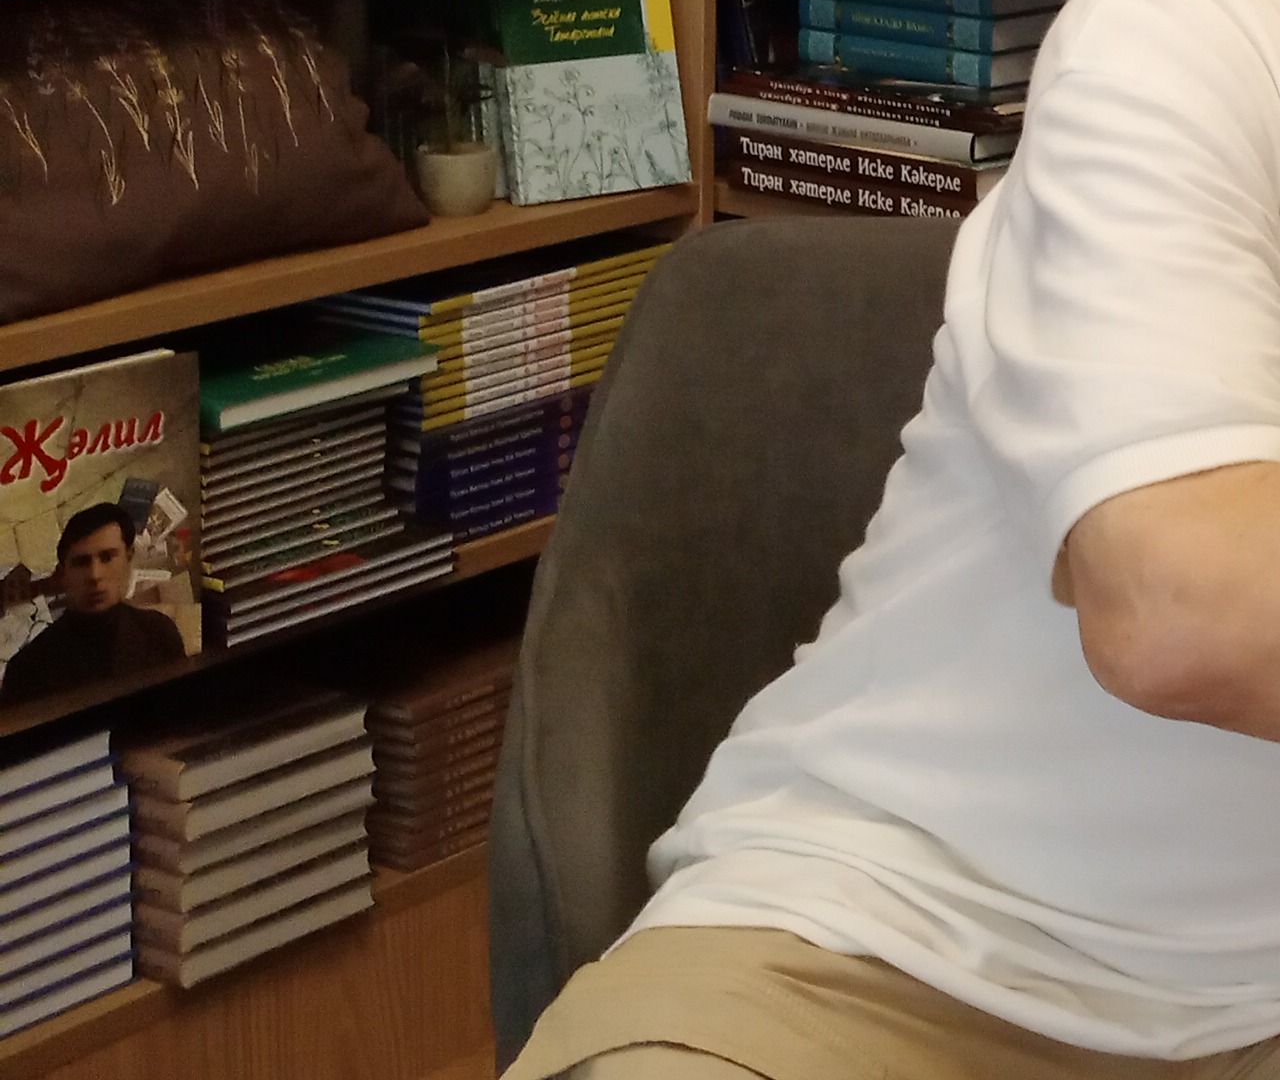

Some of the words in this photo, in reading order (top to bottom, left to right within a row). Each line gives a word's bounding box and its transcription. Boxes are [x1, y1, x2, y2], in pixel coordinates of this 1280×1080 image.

[740, 137, 782, 160] Тирән
[790, 149, 850, 173] хәтерле
[858, 157, 894, 179] Иске
[901, 165, 961, 191] Кәкерле
[741, 168, 783, 192] Тирән
[790, 179, 851, 204] хәтерле
[858, 189, 893, 211] Иске
